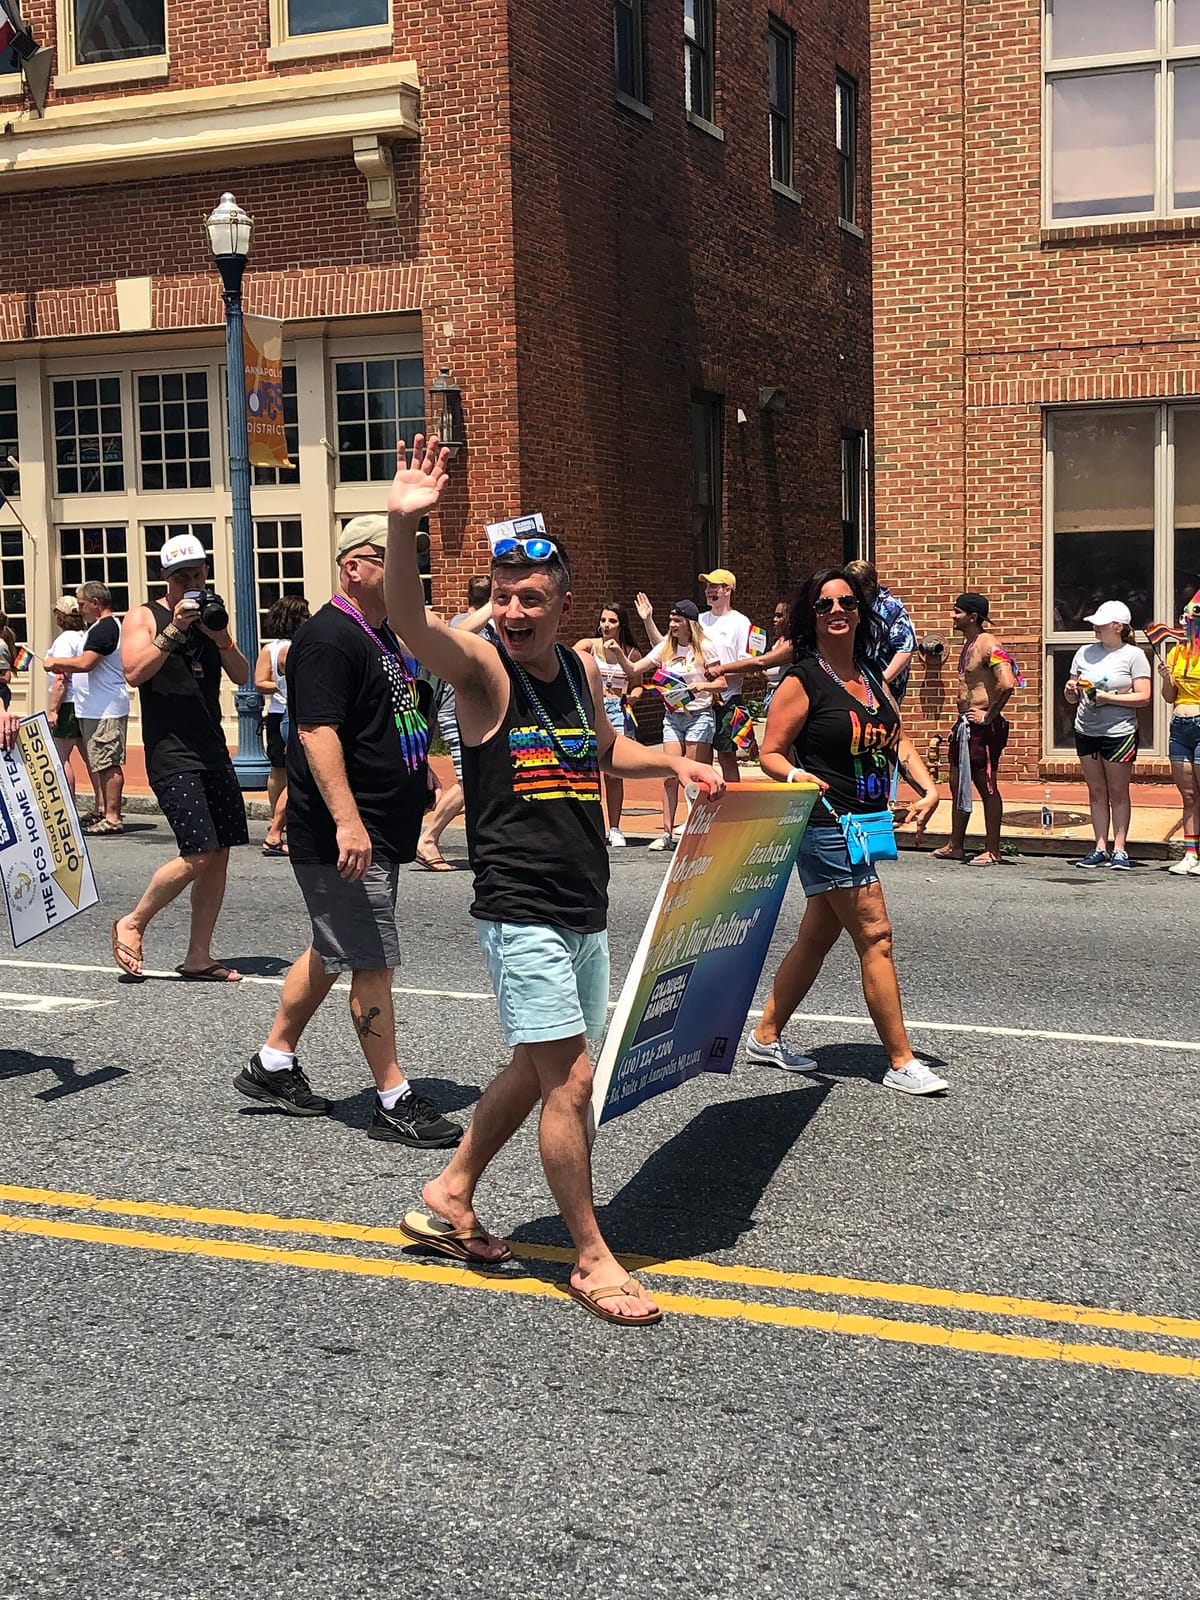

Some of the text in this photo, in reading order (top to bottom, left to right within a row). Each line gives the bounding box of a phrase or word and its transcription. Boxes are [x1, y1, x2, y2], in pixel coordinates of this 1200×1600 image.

[246, 422, 285, 436] DISTRICT
[0, 746, 21, 788] TEA
[26, 722, 61, 803] HOUSE
[16, 789, 39, 843] HOME
[22, 743, 62, 863] Chad Robertson
[54, 808, 79, 872] OPEN
[33, 846, 50, 883] PCS
[42, 885, 57, 923] THE
[680, 919, 711, 960] Your
